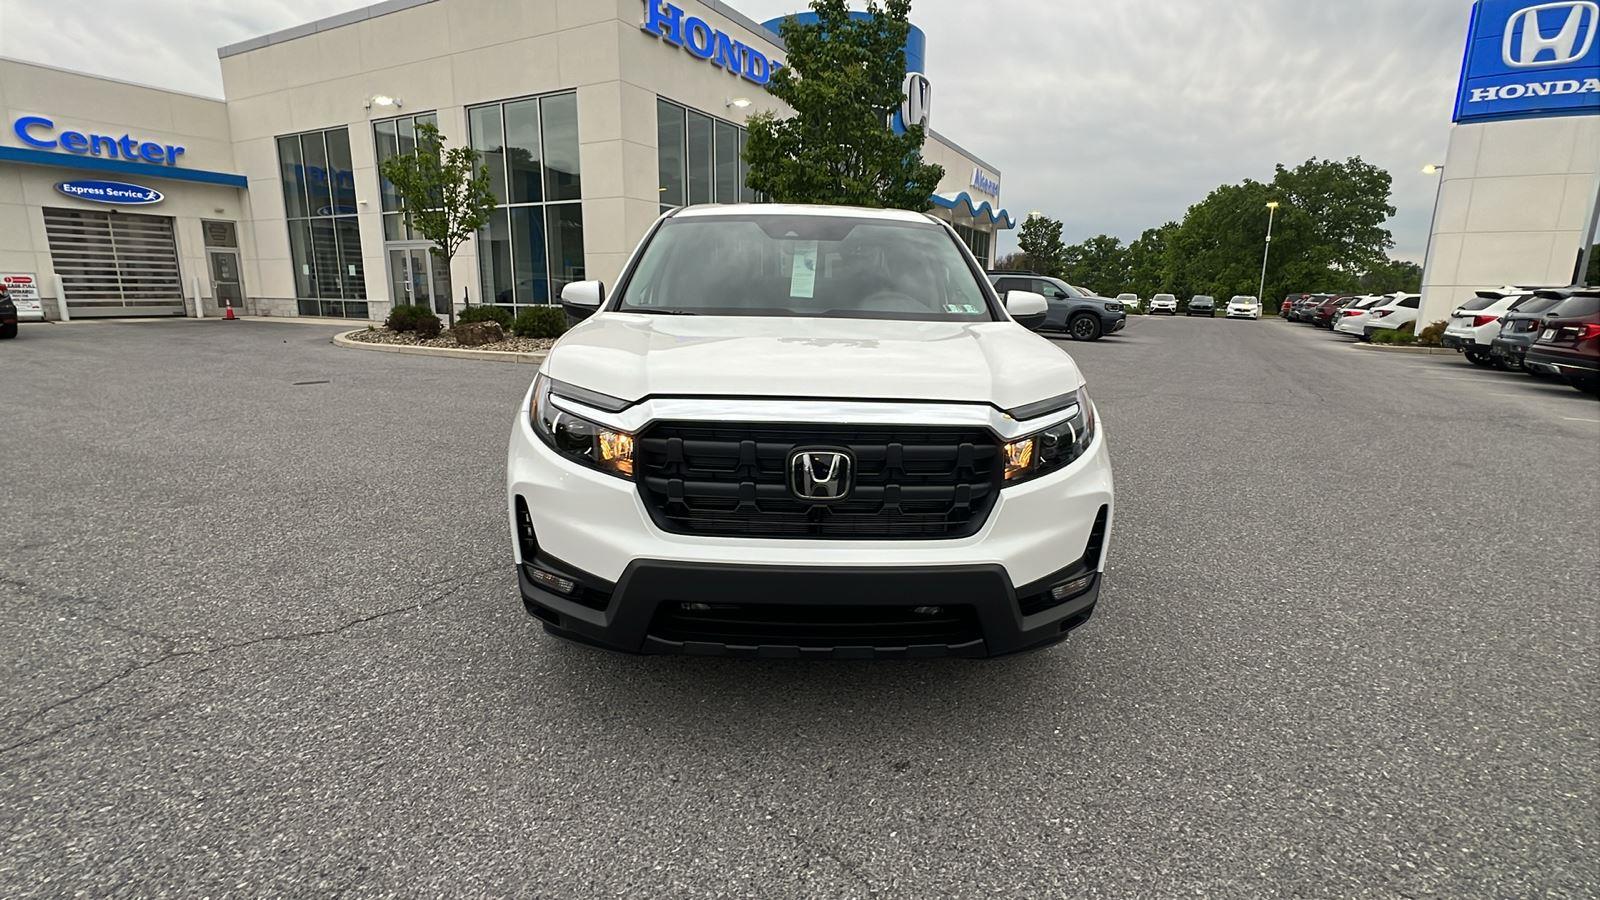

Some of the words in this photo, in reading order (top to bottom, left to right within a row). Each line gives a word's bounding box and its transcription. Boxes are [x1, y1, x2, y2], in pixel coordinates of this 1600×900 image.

[1469, 78, 1600, 102] HONDA
[14, 116, 185, 165] Center
[63, 184, 104, 194] Express
[106, 188, 143, 198] Service
